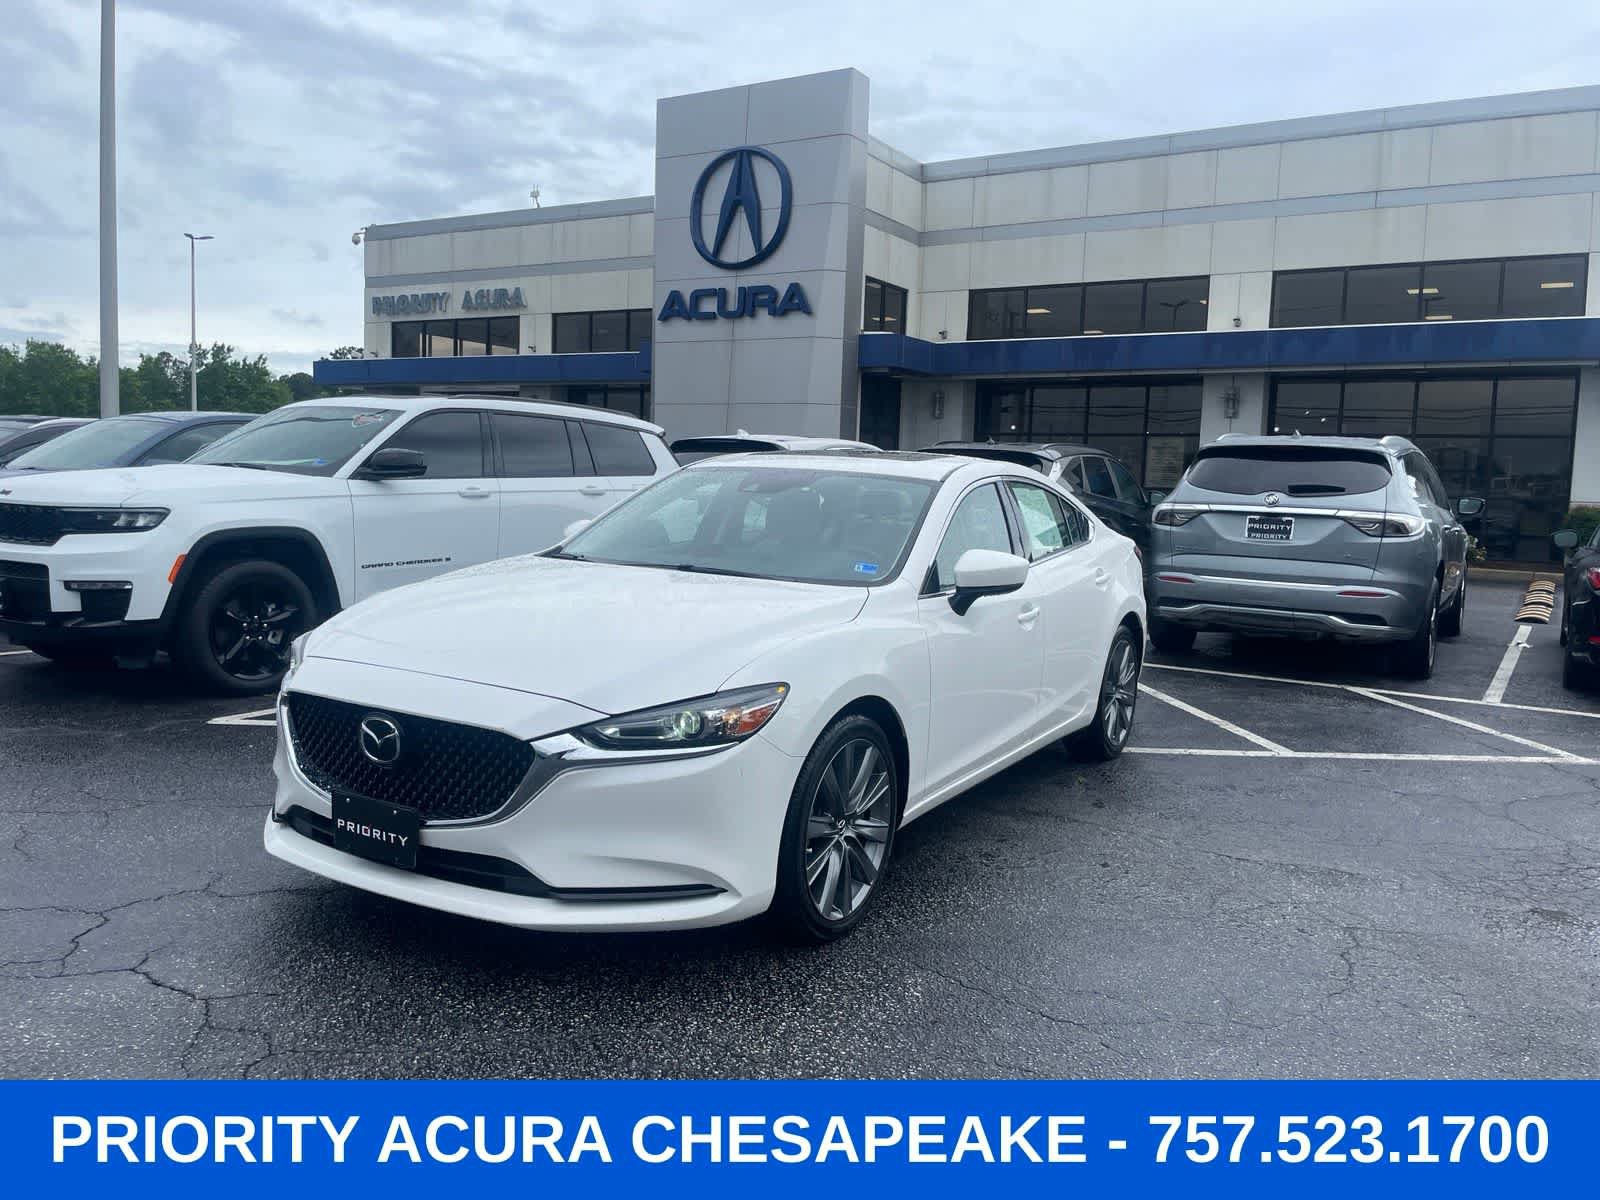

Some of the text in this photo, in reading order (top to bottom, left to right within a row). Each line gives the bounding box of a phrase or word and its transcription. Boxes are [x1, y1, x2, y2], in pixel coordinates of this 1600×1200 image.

[372, 287, 528, 316] PRIORITY ACURA
[657, 282, 814, 321] ACURA
[337, 818, 409, 847] PRIORITY
